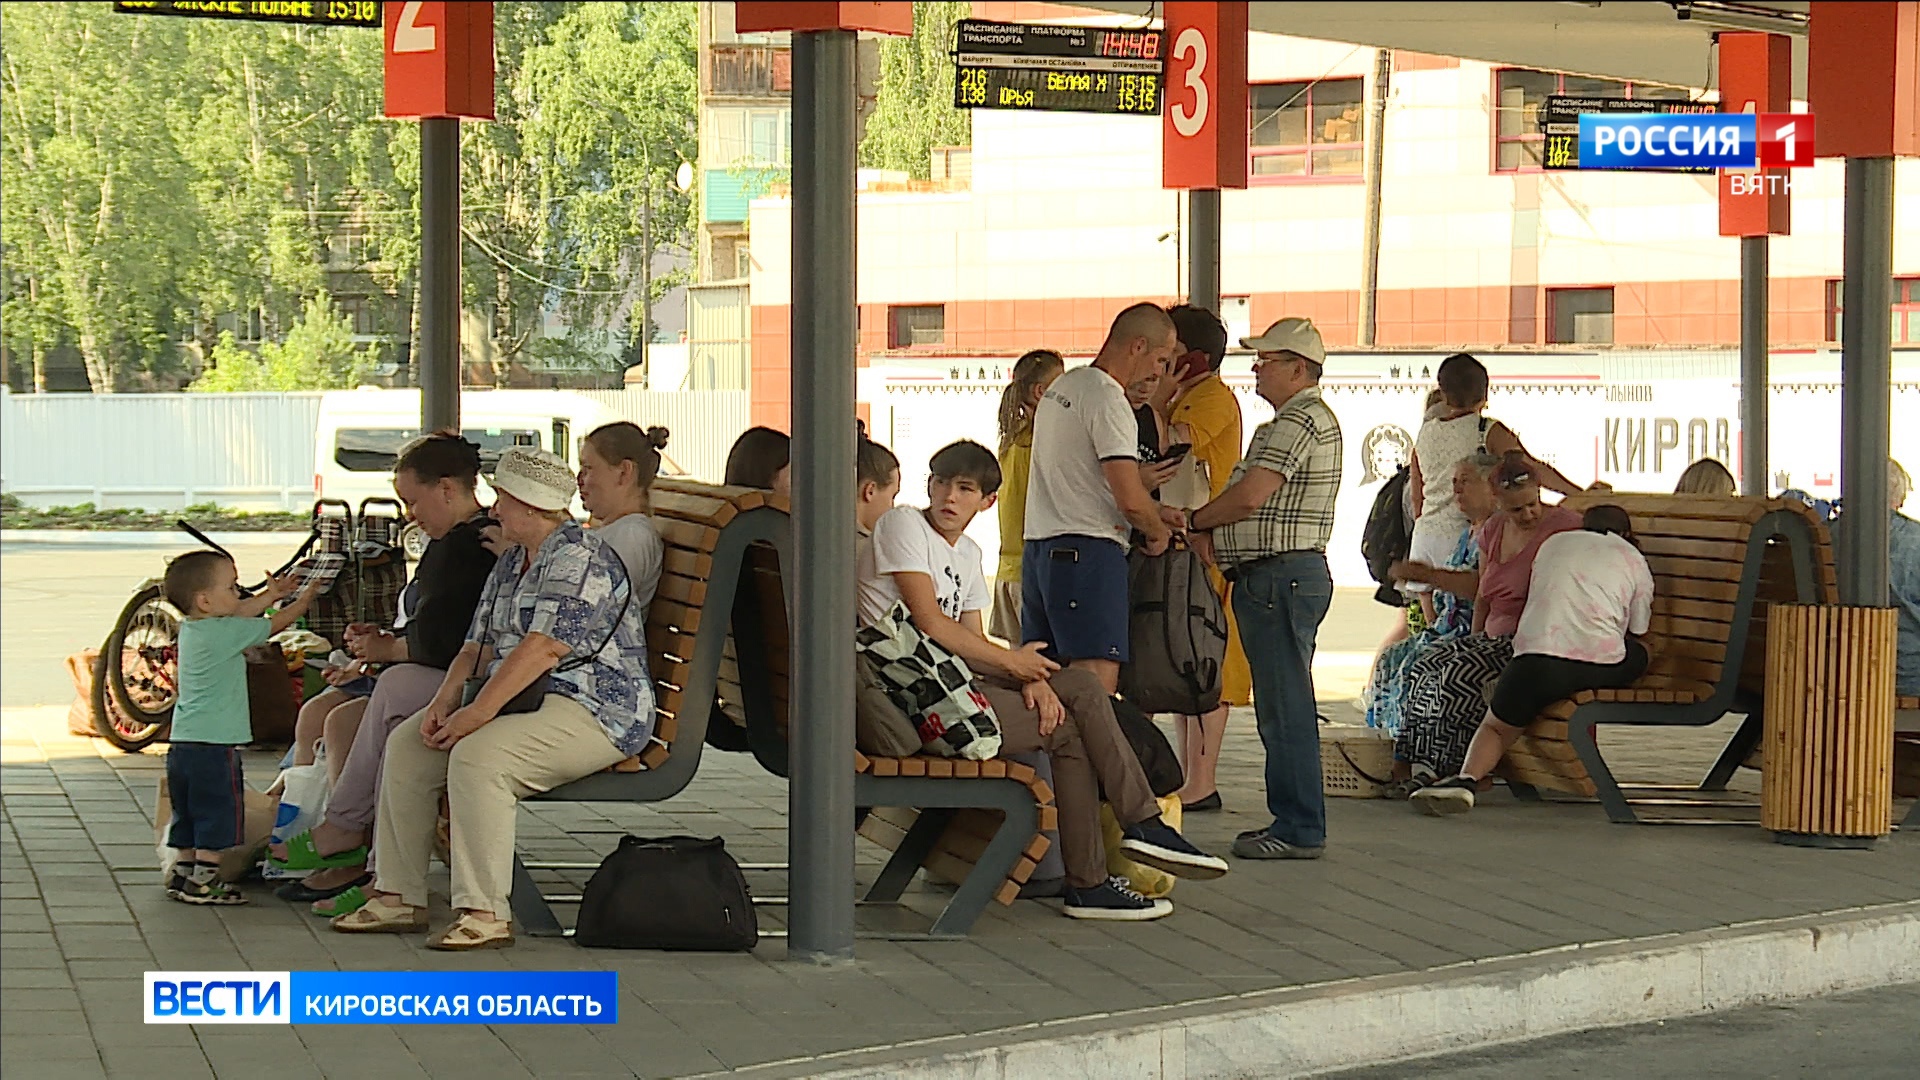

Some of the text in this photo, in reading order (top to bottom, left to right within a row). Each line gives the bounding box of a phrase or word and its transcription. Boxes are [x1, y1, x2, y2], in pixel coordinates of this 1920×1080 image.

[327, 2, 376, 21] 15:10
[963, 23, 1025, 34] РАСПИСАНИЕ
[963, 34, 1023, 44] ТРАНСПОРТА
[1031, 27, 1086, 36] ПЛАТФОРМА
[961, 68, 987, 86] 216
[1048, 72, 1090, 91] БЕЛАЯ
[1118, 75, 1156, 93] 15:15
[1171, 28, 1209, 137] 3
[961, 86, 1156, 110] 138 ЮРЬЯ 15:15
[1604, 417, 1729, 474] КИРОВ
